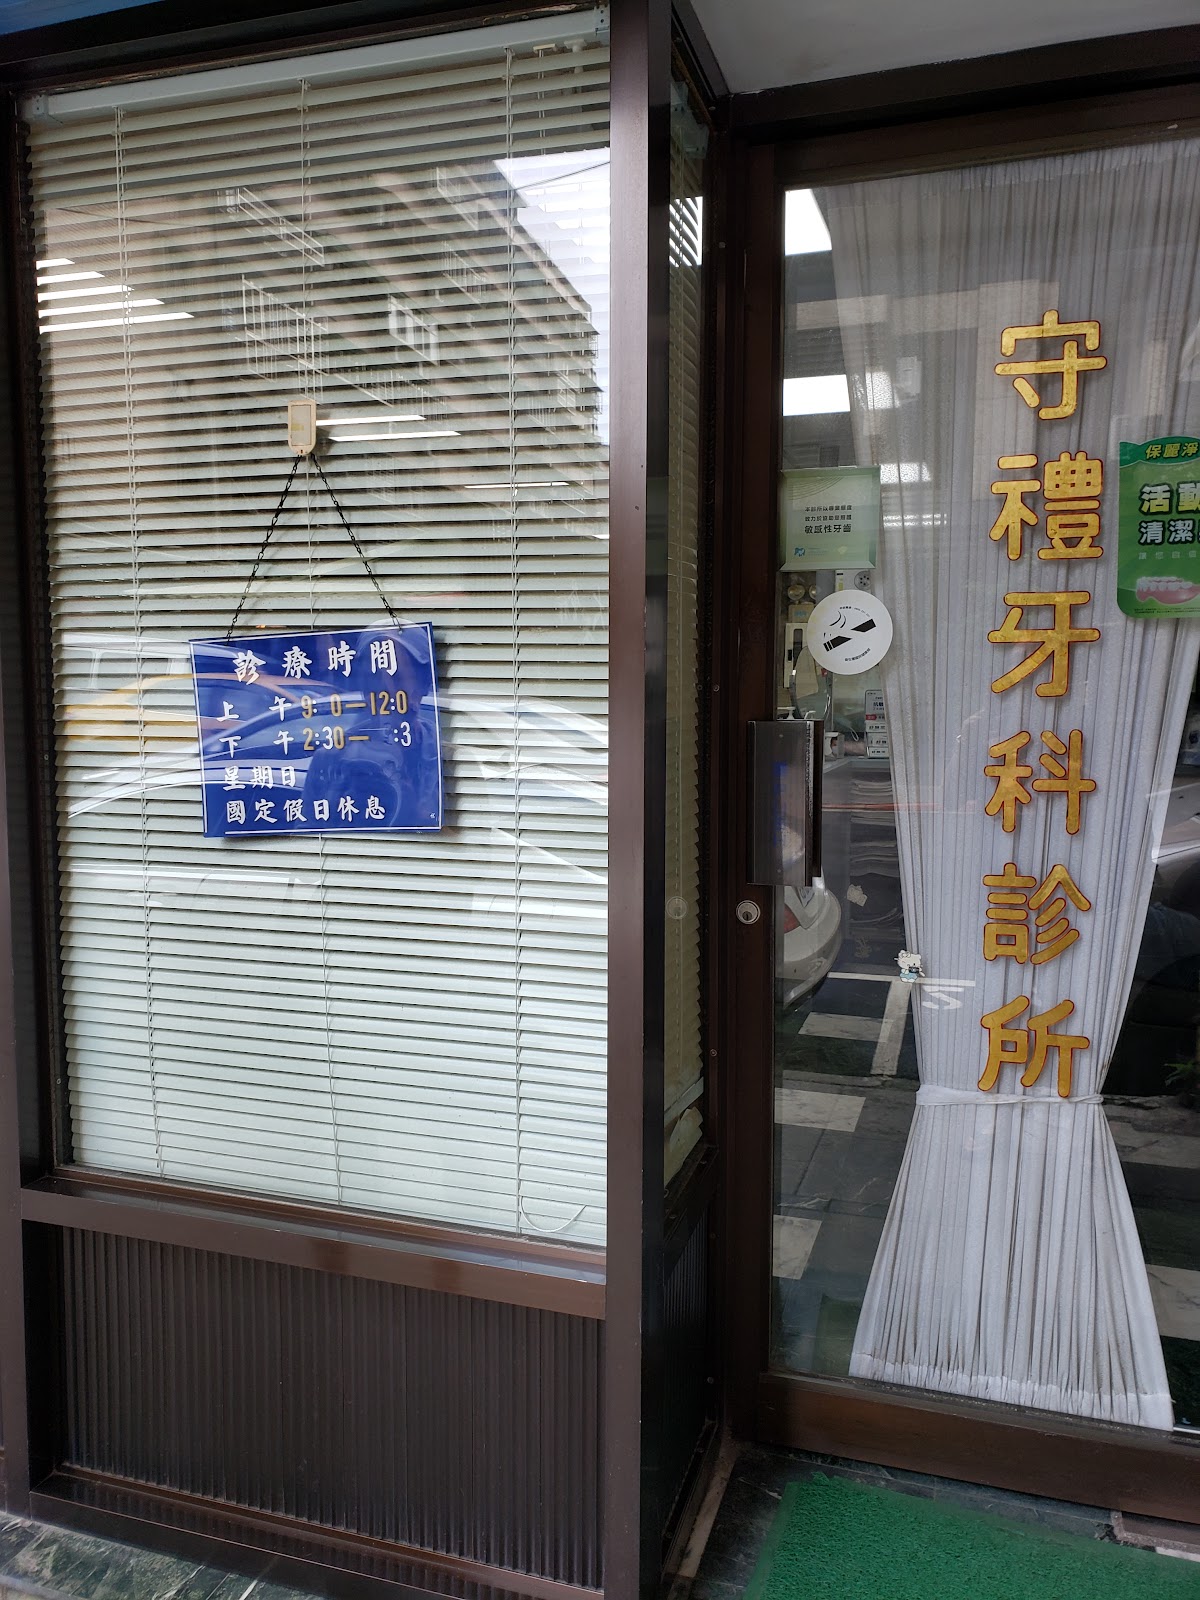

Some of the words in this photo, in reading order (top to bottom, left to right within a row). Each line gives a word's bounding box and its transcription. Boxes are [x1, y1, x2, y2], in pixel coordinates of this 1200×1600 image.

[1145, 442, 1199, 459] 保麗淨
[804, 523, 852, 534] 敏感性牙齒
[1139, 520, 1200, 544] 清潔
[232, 639, 399, 685] 診療時間
[977, 309, 1108, 1098] 守禮牙科診所
[222, 765, 297, 791] 星期日
[226, 795, 386, 825] 國定假日休息
